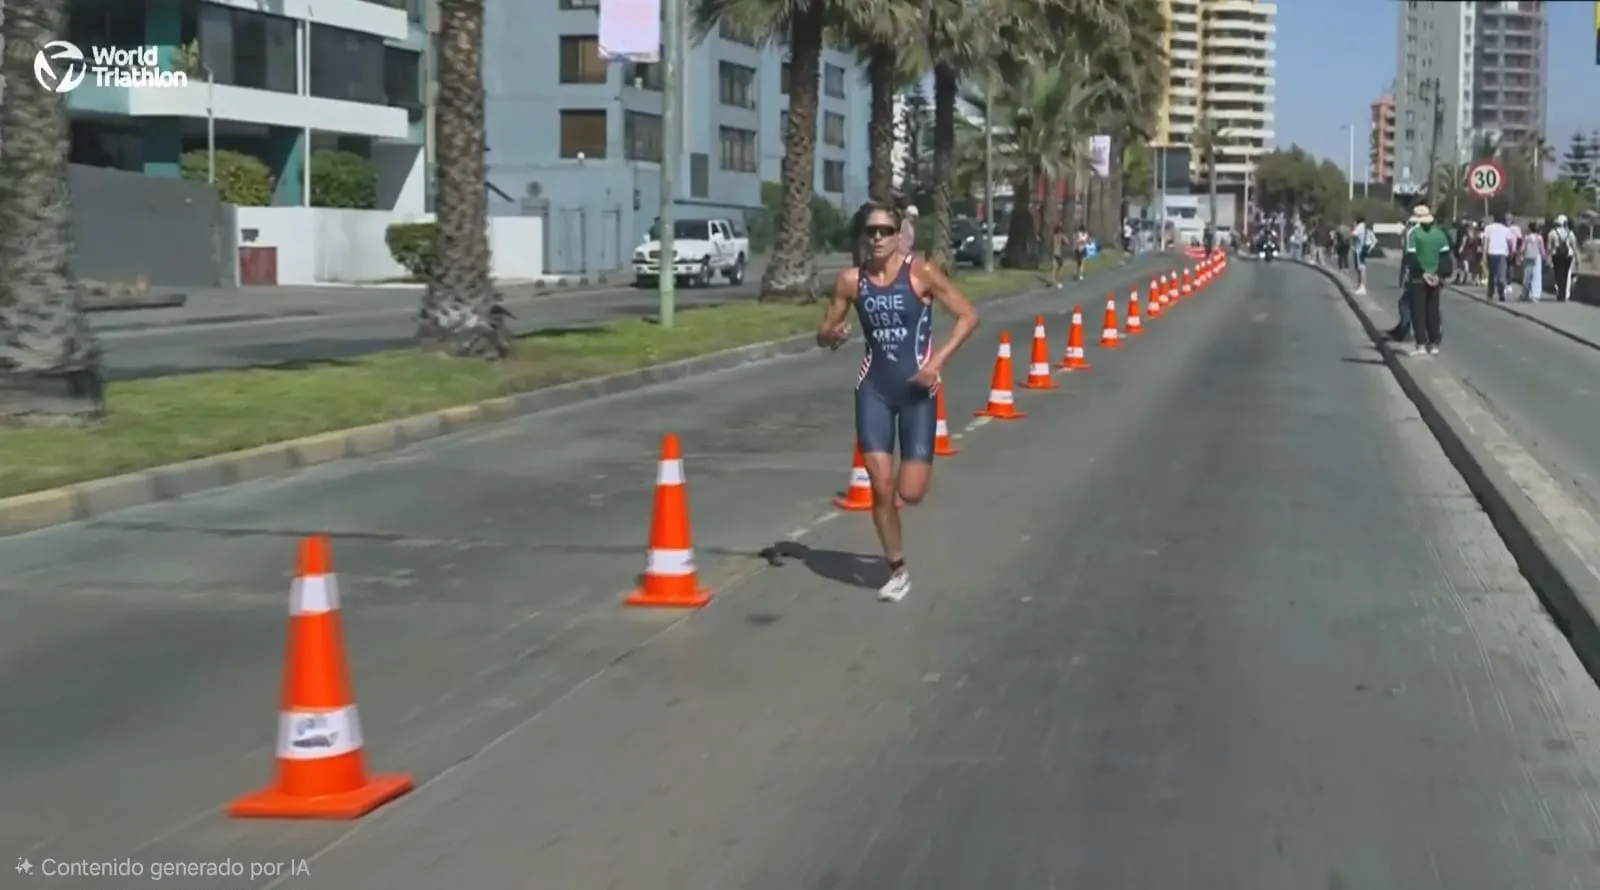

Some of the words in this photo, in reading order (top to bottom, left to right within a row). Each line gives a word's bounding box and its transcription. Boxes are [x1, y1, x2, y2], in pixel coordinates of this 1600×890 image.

[1475, 170, 1496, 189] 30
[864, 294, 904, 312] ORIE
[868, 312, 902, 327] USA
